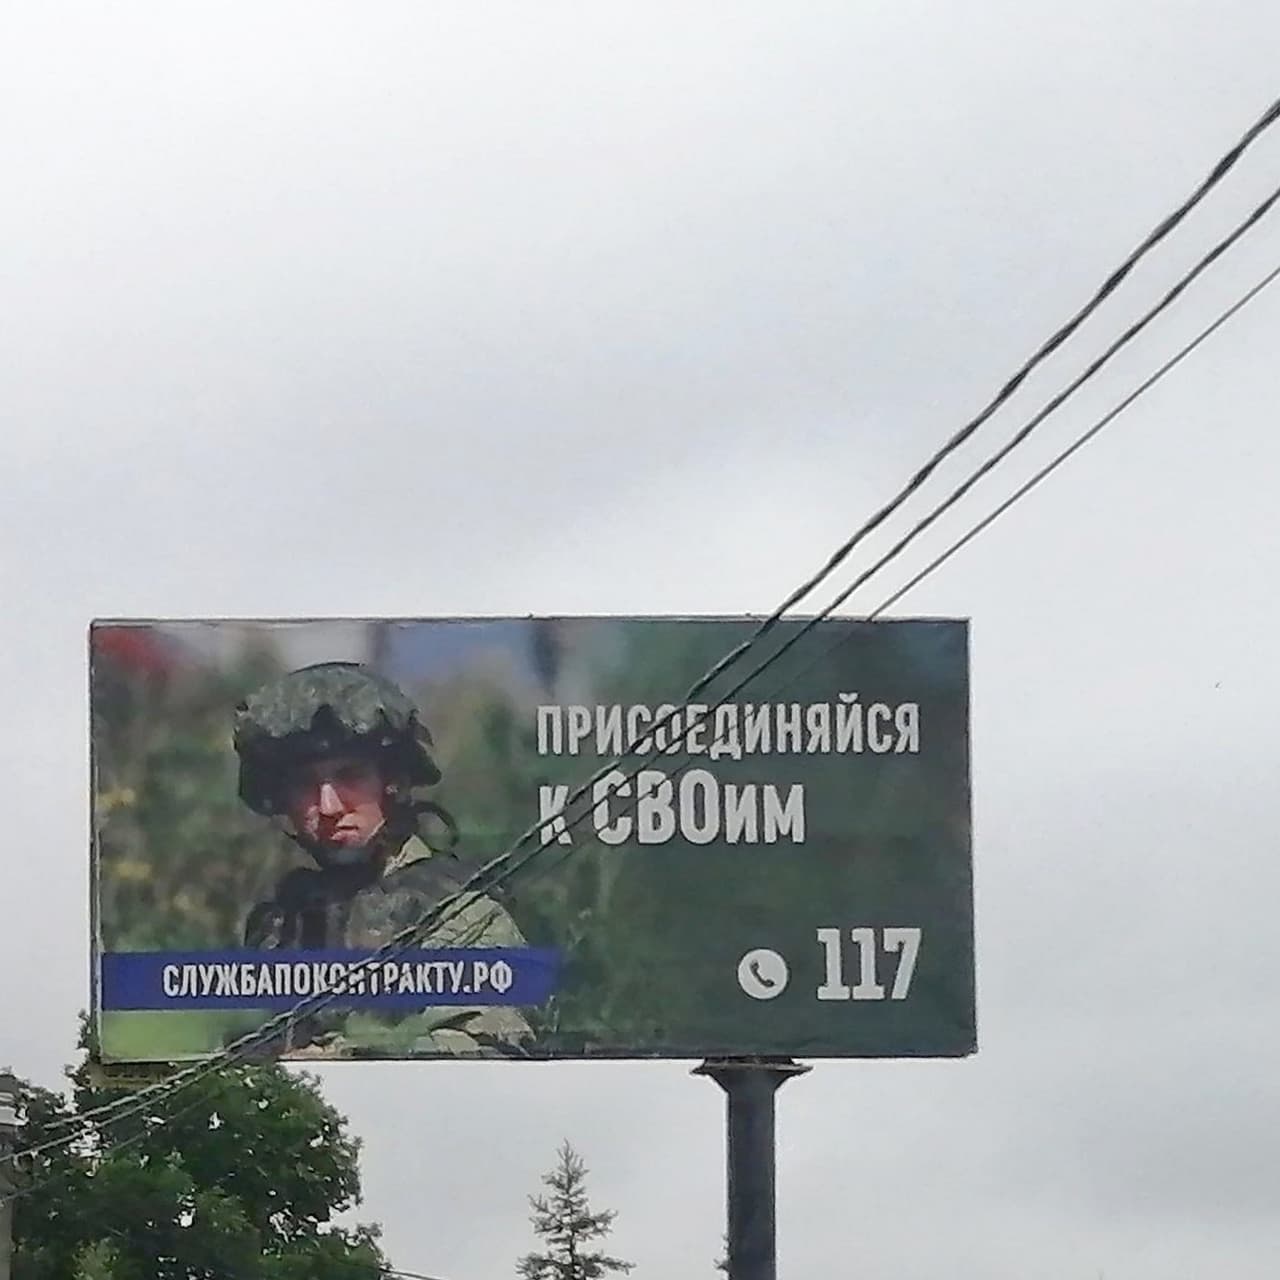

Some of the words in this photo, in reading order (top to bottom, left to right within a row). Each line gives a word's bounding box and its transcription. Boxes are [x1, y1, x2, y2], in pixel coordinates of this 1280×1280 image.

[537, 692, 920, 760] ПРИСОЕДИНЯЙСЯ
[162, 959, 514, 998] СЛУЖБАПОКОНТРАКТУ.РФ
[816, 927, 922, 1000] 117
